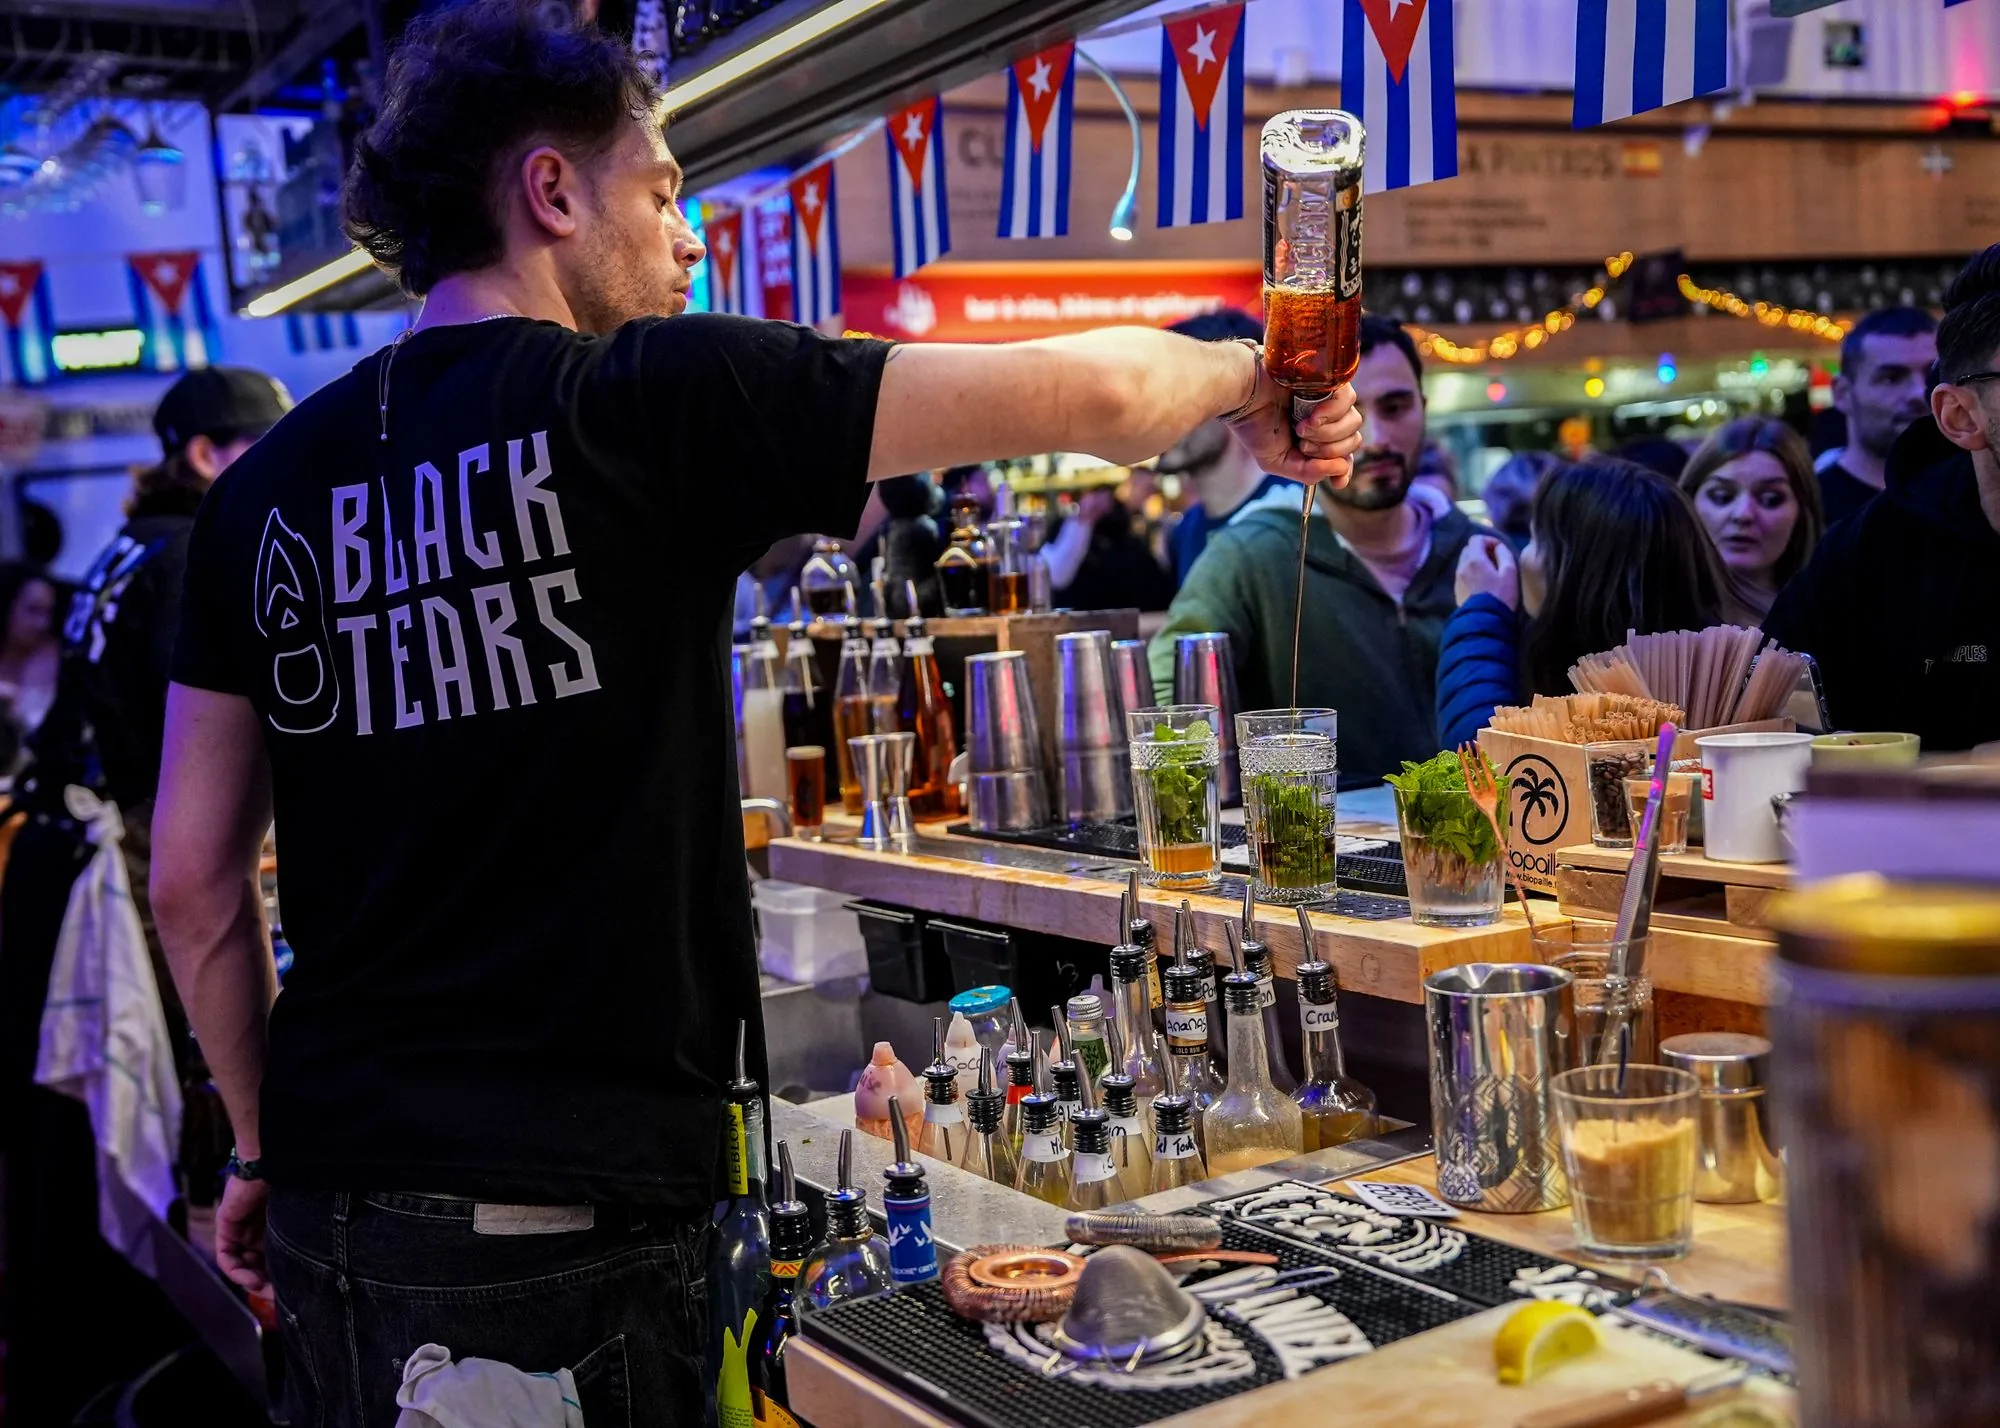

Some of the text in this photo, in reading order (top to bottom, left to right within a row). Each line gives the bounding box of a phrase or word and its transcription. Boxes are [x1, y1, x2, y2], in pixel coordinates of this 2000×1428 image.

[331, 430, 571, 603] BLACK
[337, 568, 602, 735] TEARS
[728, 1114, 742, 1185] LEBLON
